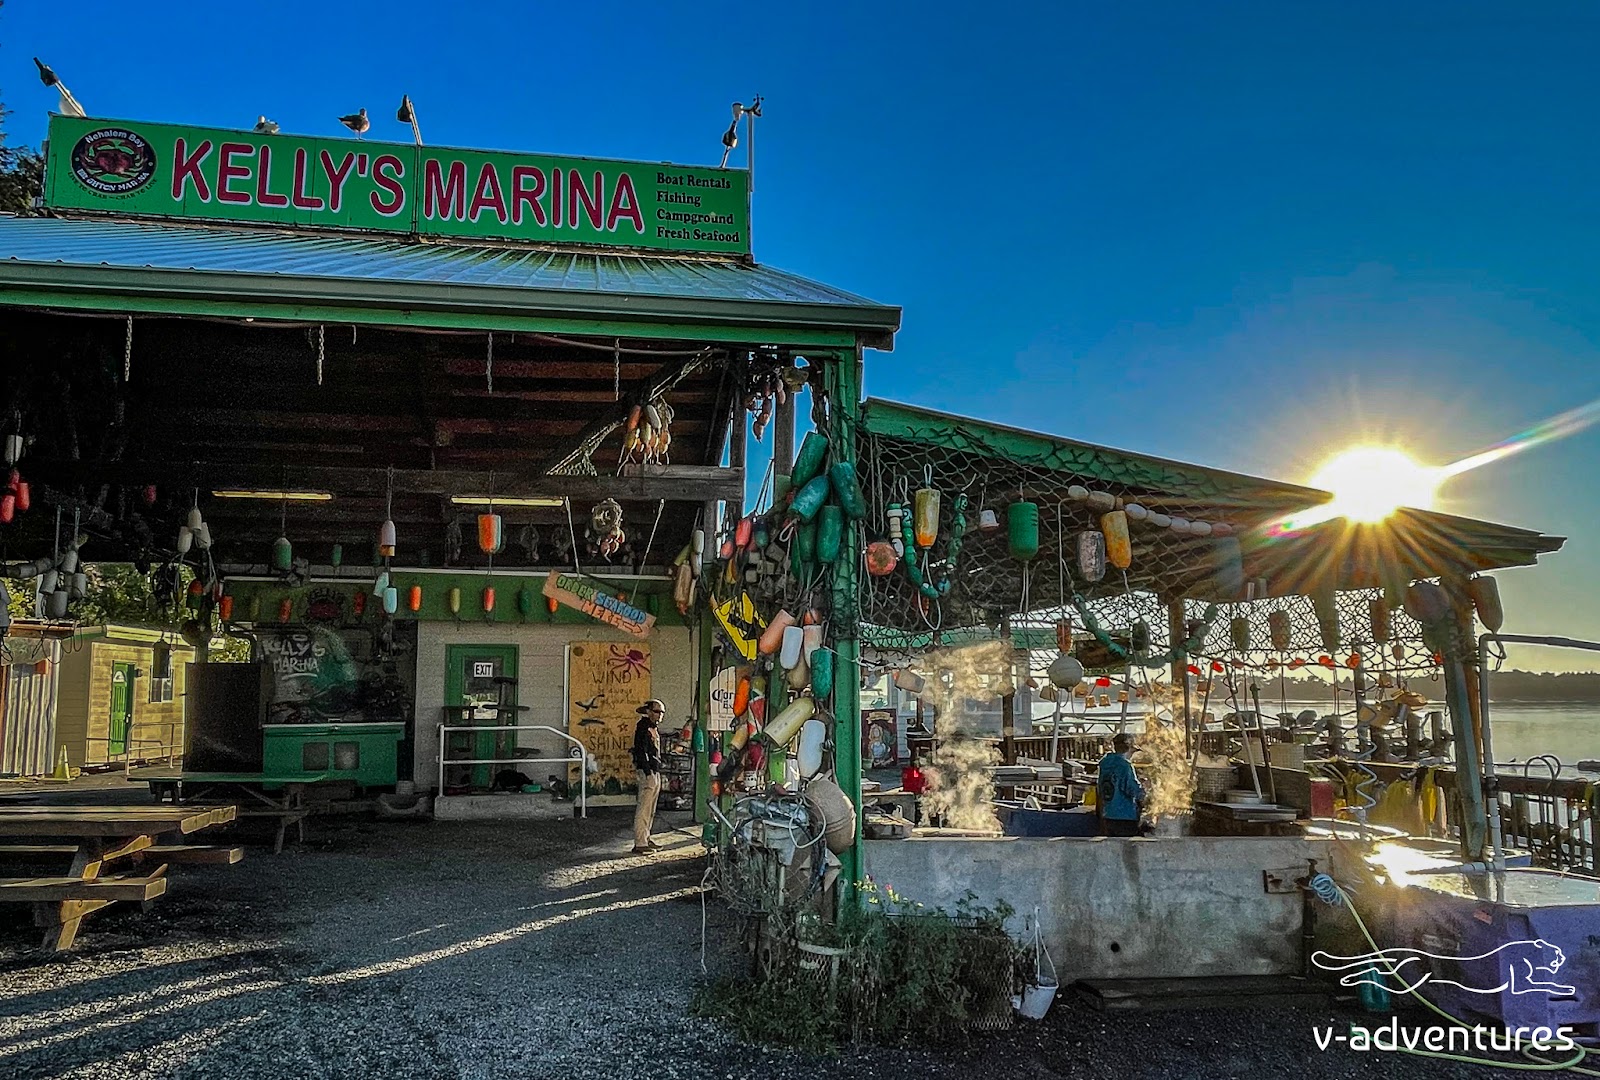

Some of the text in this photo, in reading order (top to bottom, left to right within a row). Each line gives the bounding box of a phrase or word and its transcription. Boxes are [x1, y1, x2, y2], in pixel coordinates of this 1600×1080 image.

[84, 129, 145, 148] Nehalem Bay
[76, 168, 117, 191] BRGHTON
[171, 137, 645, 234] KELLY'S MARINA
[656, 172, 731, 189] Boat Rentals
[656, 190, 701, 208] Fishing
[656, 208, 734, 225] Campground
[656, 226, 740, 243] Fresh Seafood
[556, 574, 647, 625] ORDER SEAFOOD
[581, 600, 623, 627] HERE
[475, 664, 491, 675] EXIT
[592, 671, 631, 684] WIND
[712, 689, 735, 703] Cor
[588, 736, 631, 751] SHINE
